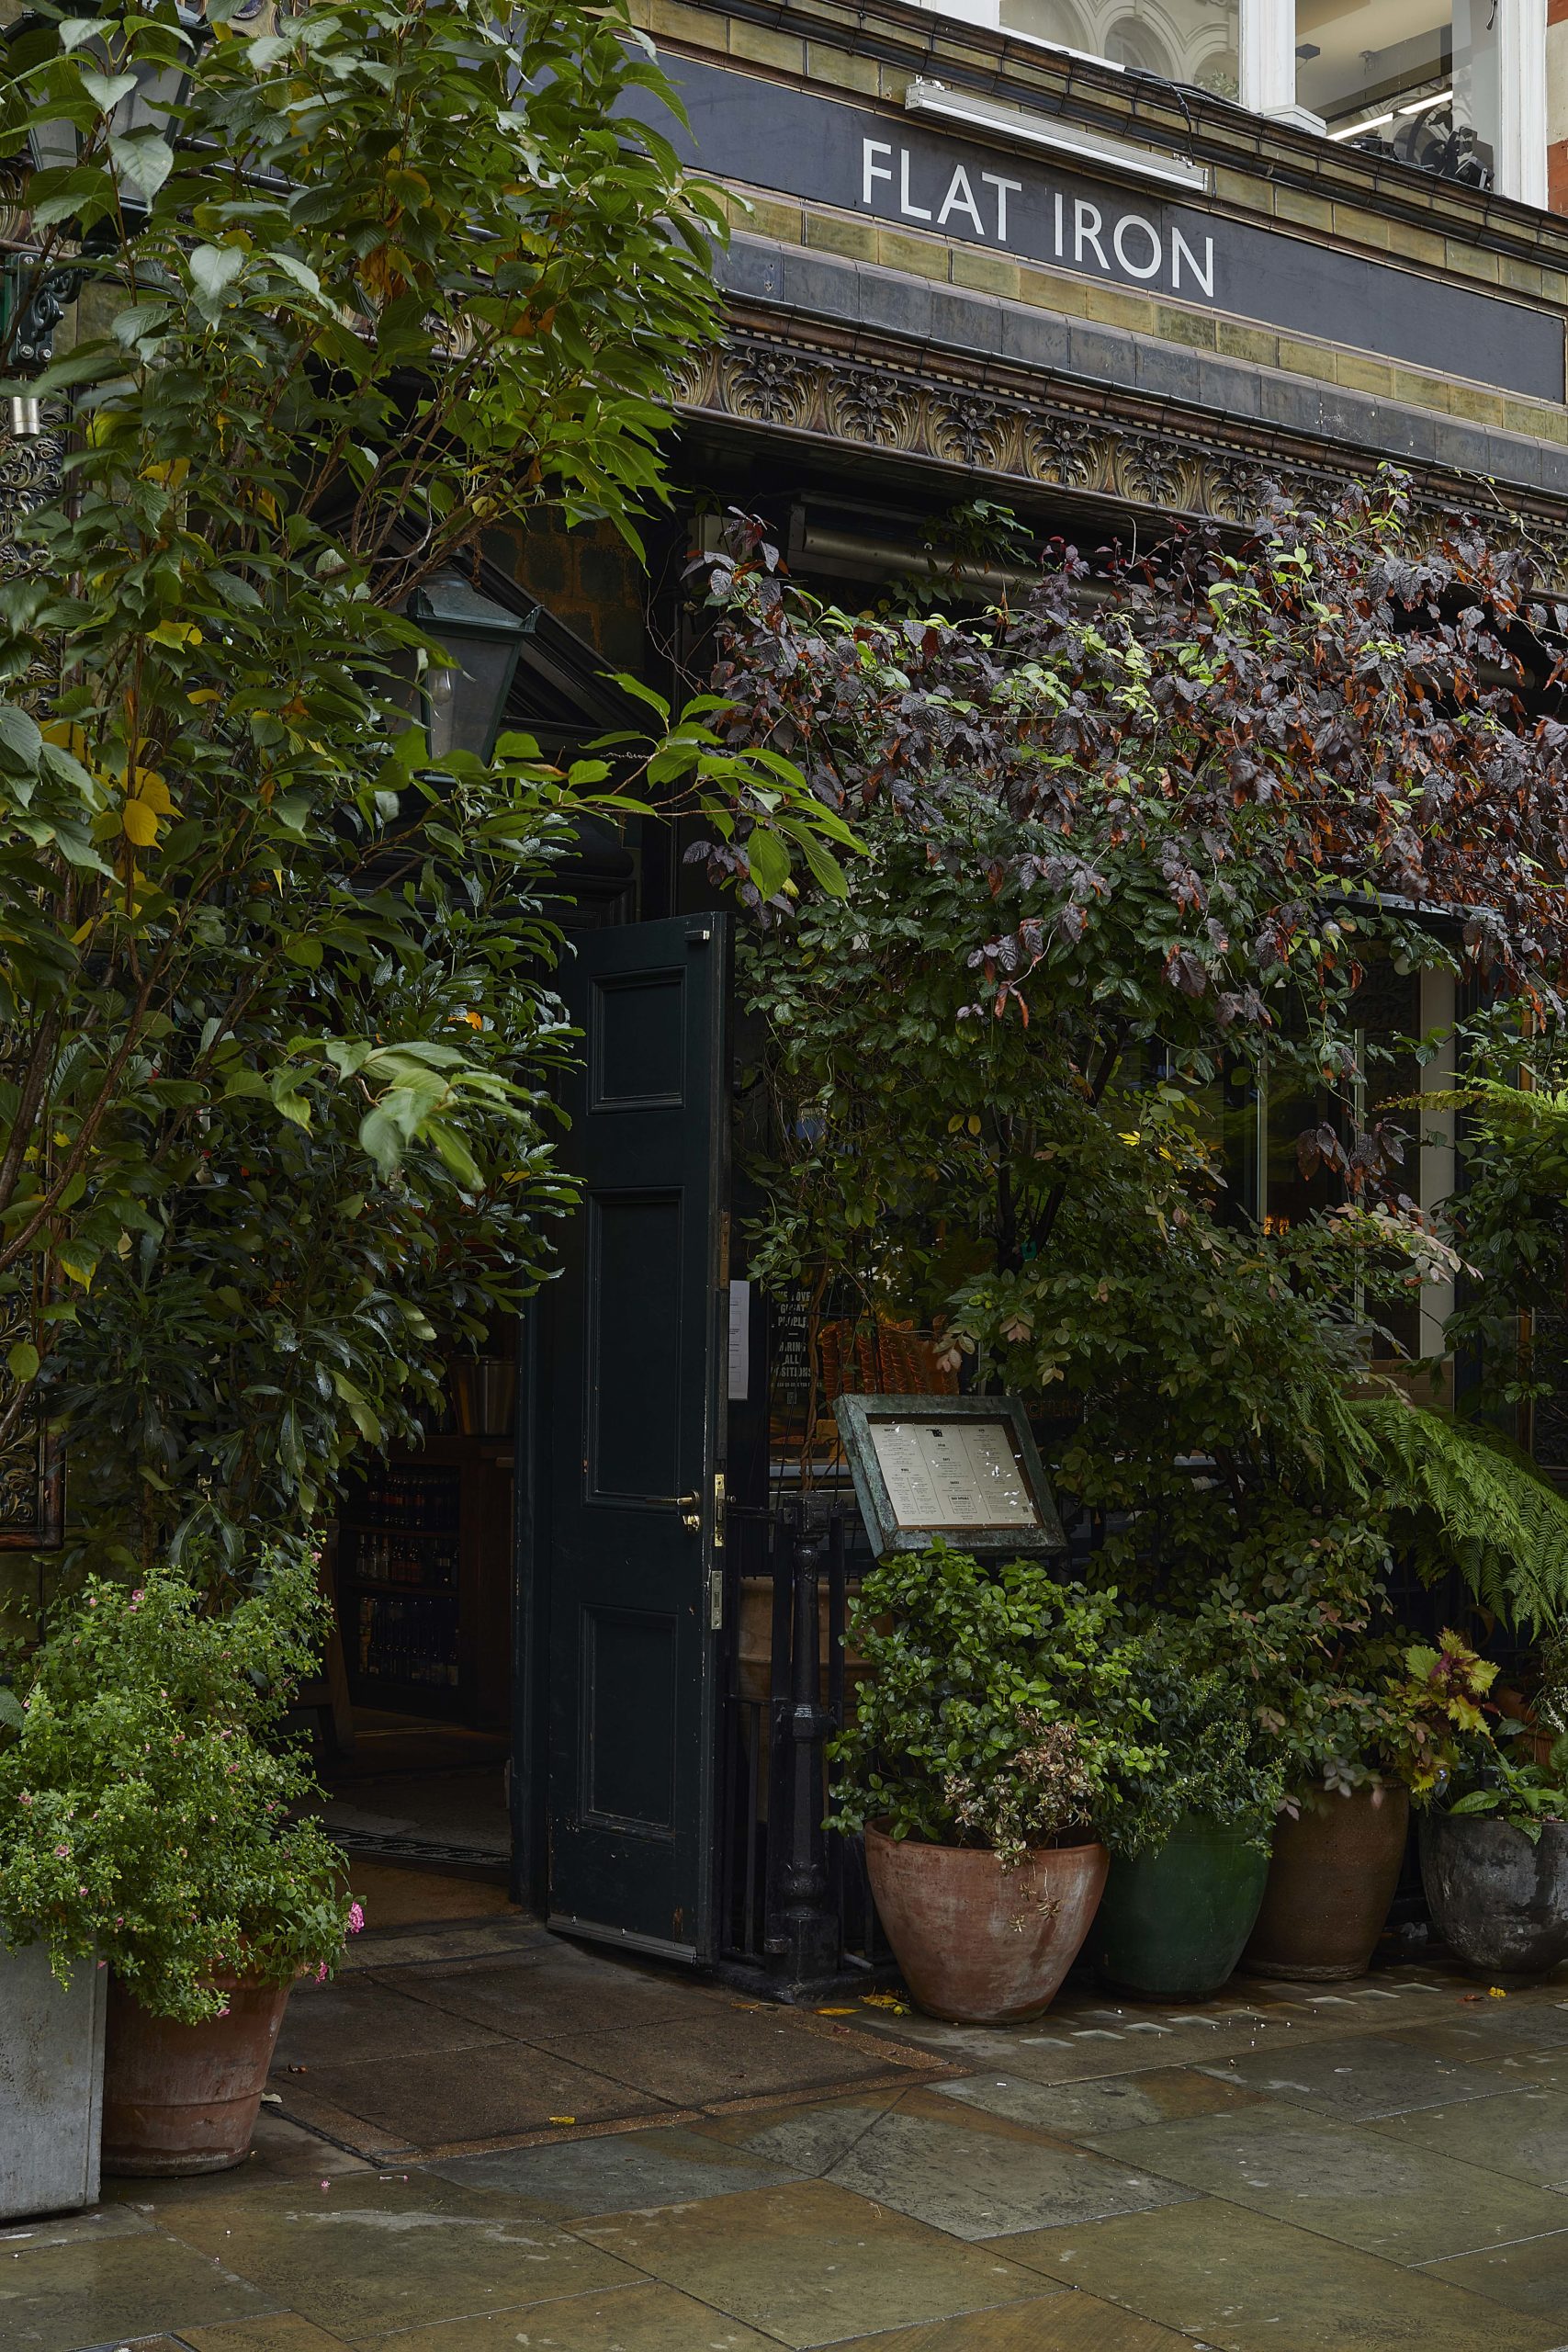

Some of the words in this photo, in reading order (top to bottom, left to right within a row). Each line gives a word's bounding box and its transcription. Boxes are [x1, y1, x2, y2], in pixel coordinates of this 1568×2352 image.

[863, 138, 1022, 242] FLAT
[1055, 193, 1214, 299] IRON
[785, 1353, 799, 1365] ALL
